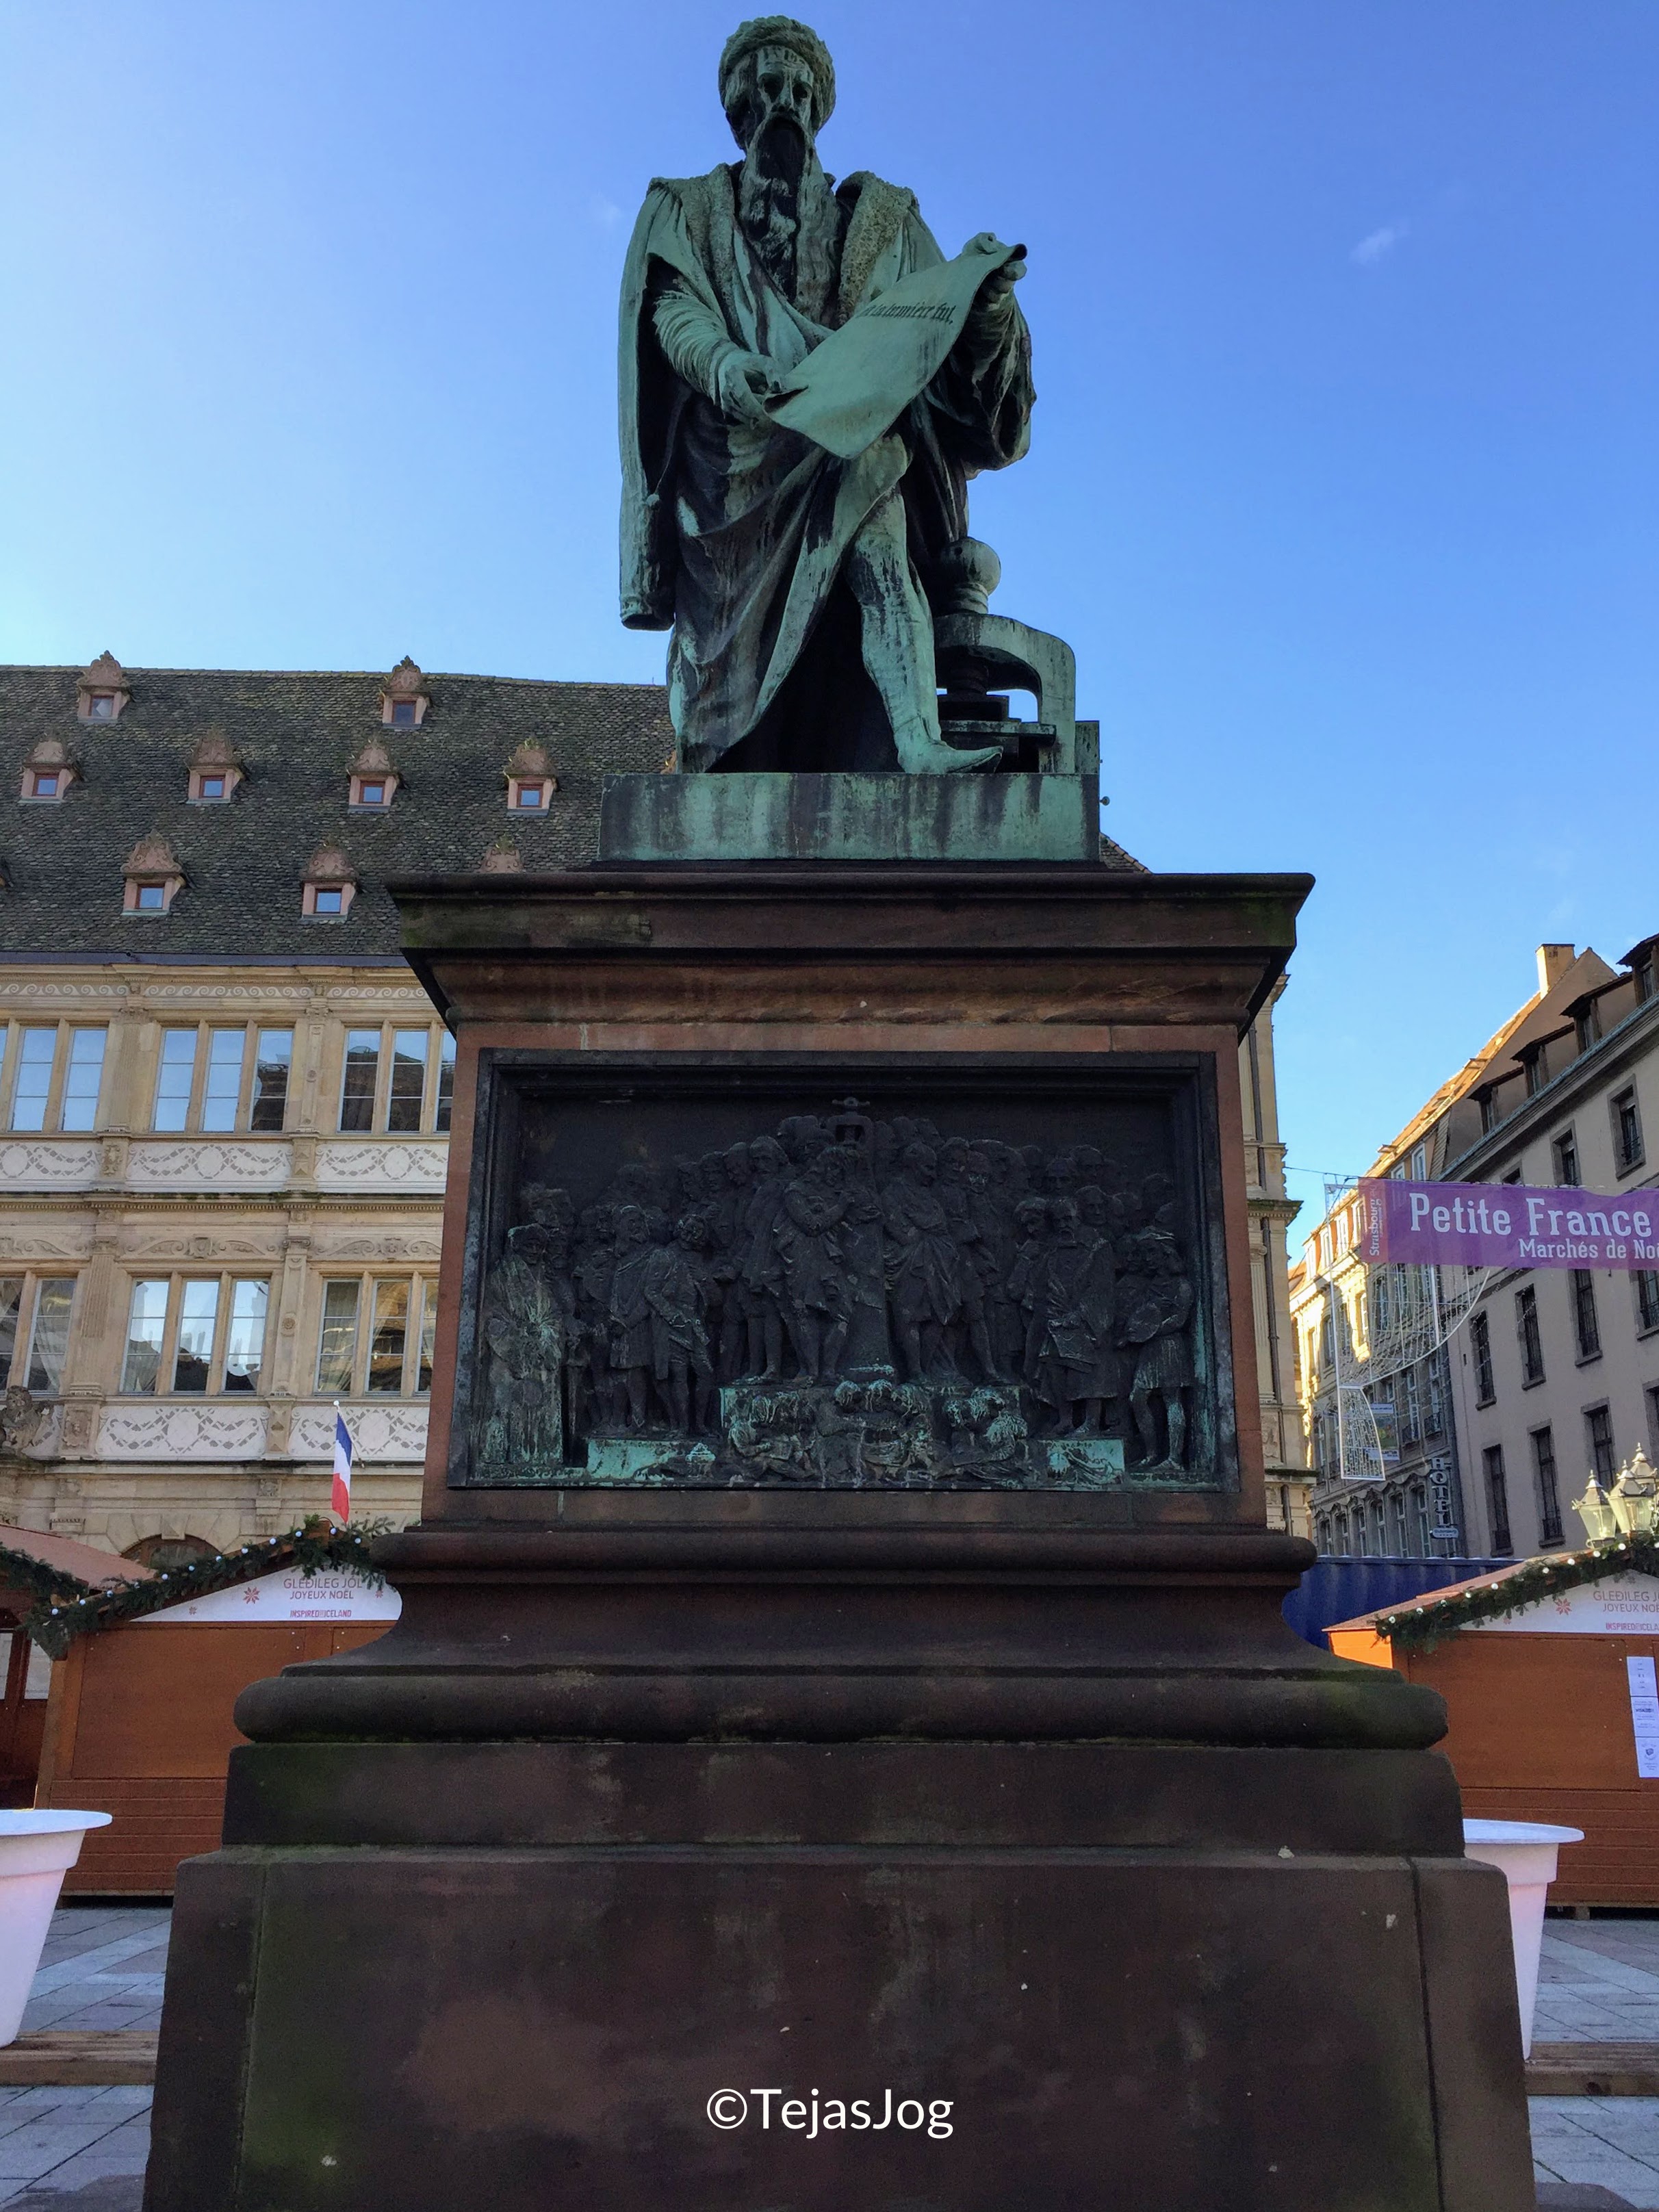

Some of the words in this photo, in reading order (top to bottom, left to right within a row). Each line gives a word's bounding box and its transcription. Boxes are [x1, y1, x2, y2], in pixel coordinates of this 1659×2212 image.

[1409, 1192, 1512, 1236] Petite
[1526, 1198, 1652, 1237] France
[1519, 1238, 1598, 1259] Marchés
[1606, 1239, 1627, 1259] de
[1429, 1457, 1451, 1526] HOTEL
[290, 1591, 326, 1599] JOYEUX
[1603, 1604, 1639, 1612] JOYEUX
